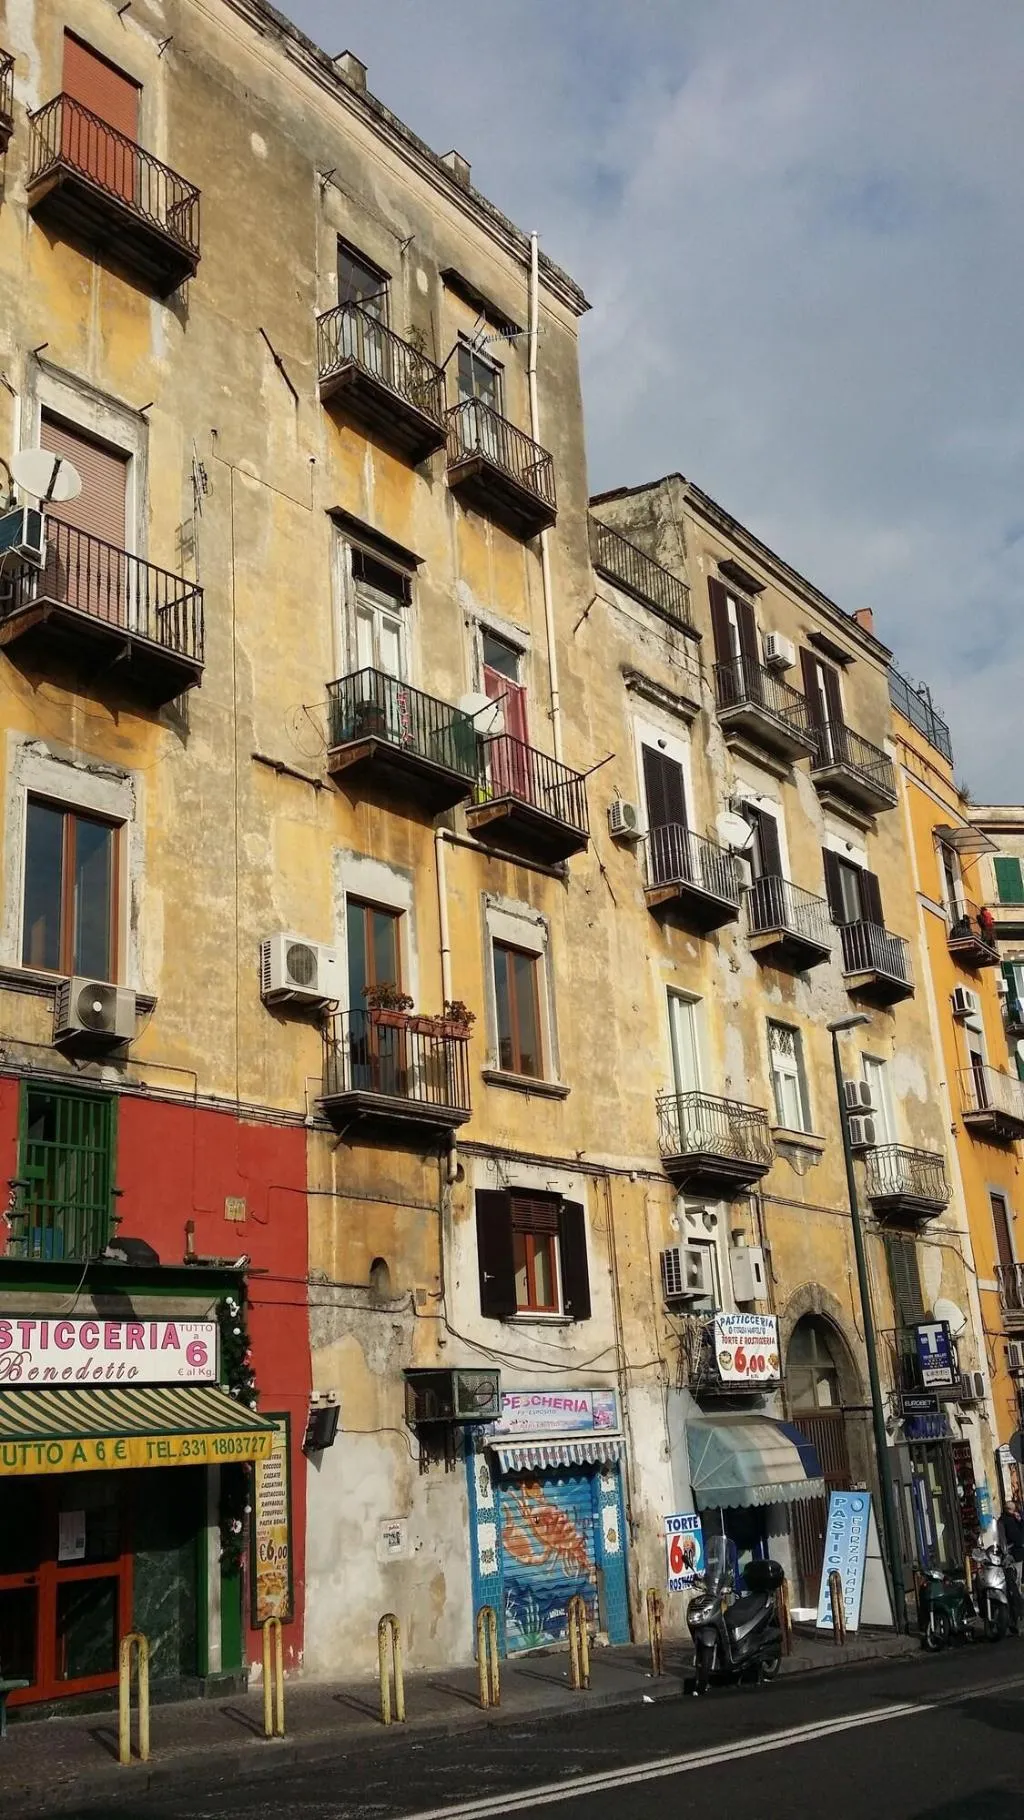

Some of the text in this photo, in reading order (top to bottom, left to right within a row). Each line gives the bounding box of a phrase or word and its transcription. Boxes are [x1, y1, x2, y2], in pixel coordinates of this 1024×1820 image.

[179, 1323, 213, 1332] TUTTO
[720, 1315, 774, 1328] PASTICCERIA
[722, 1336, 738, 1345] TORTE
[744, 1336, 776, 1345] ROSTICCERIA
[917, 1324, 943, 1353] T
[186, 1341, 208, 1367] 6
[735, 1346, 766, 1376] 6,00
[0, 1350, 139, 1381] Benedetto
[502, 1395, 588, 1412] PESCHERIA
[0, 1439, 126, 1466] UTTO A 6 €
[212, 1436, 266, 1456] 1803727
[667, 1516, 698, 1532] TORTE
